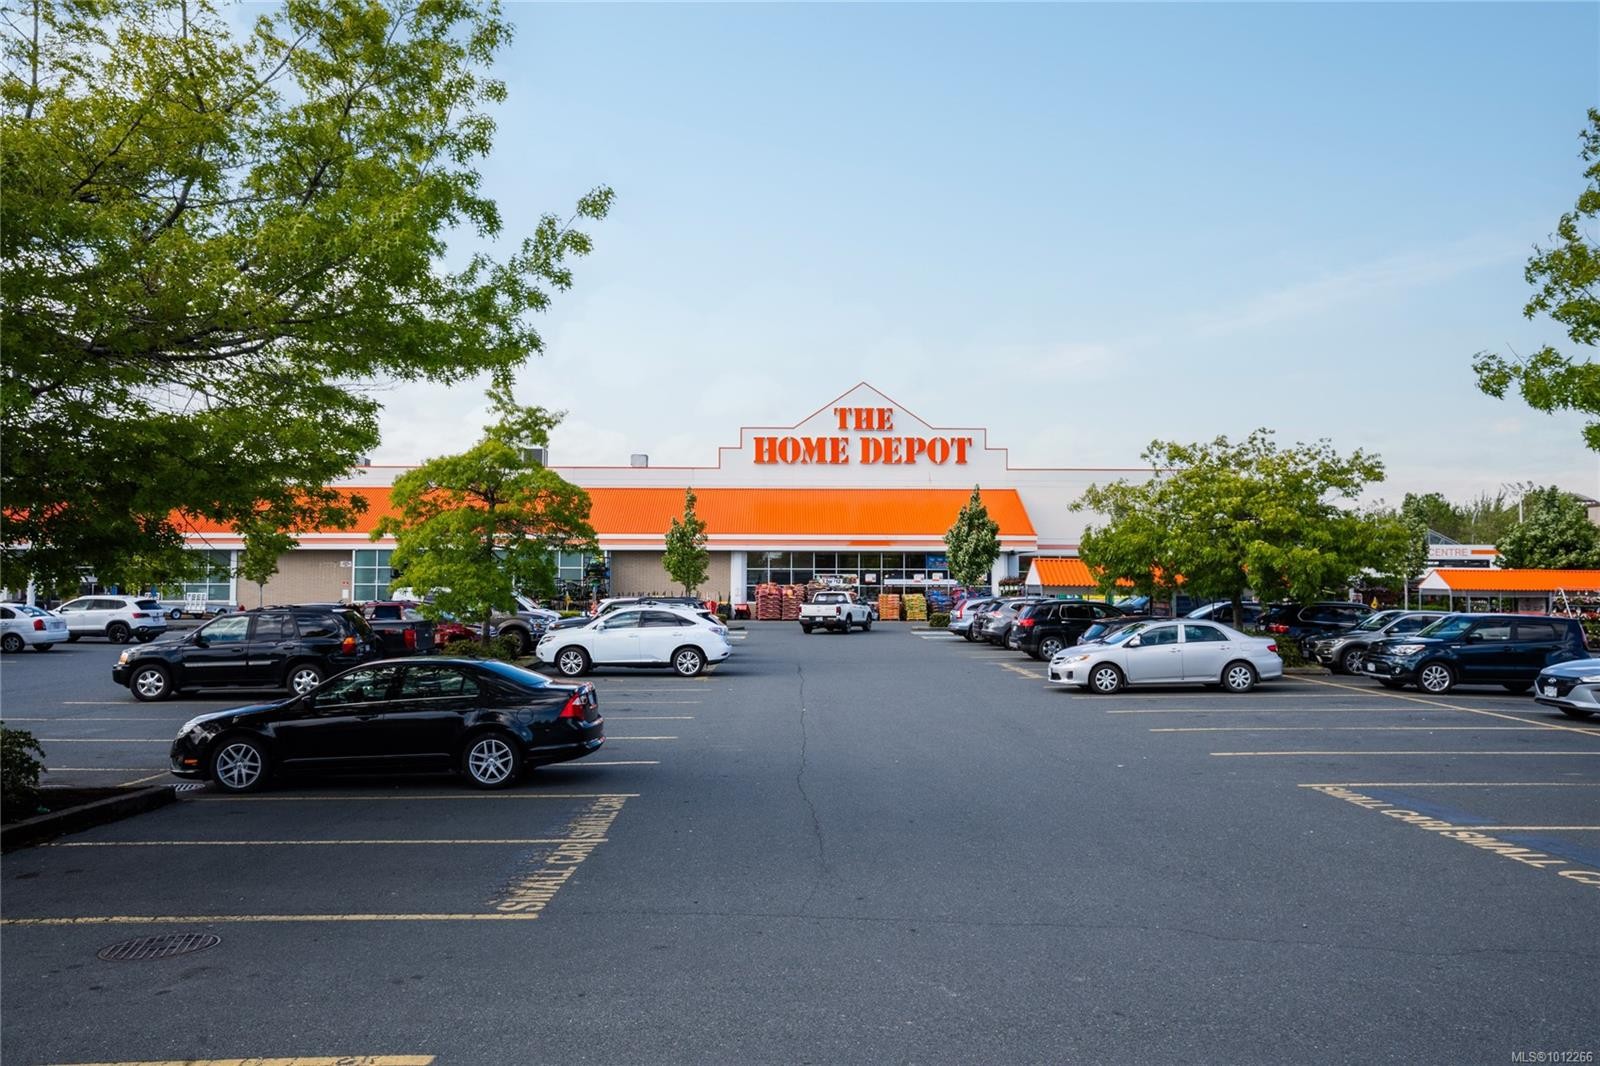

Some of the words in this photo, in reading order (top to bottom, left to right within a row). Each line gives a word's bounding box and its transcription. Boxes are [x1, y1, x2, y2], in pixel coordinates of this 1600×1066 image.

[834, 408, 894, 431] THE
[753, 437, 849, 465] HOME
[860, 437, 973, 465] DEPOT
[1381, 809, 1452, 830] CAR
[1440, 831, 1567, 869] SMALL
[496, 866, 578, 912] SMALL
[545, 842, 599, 864] CAR
